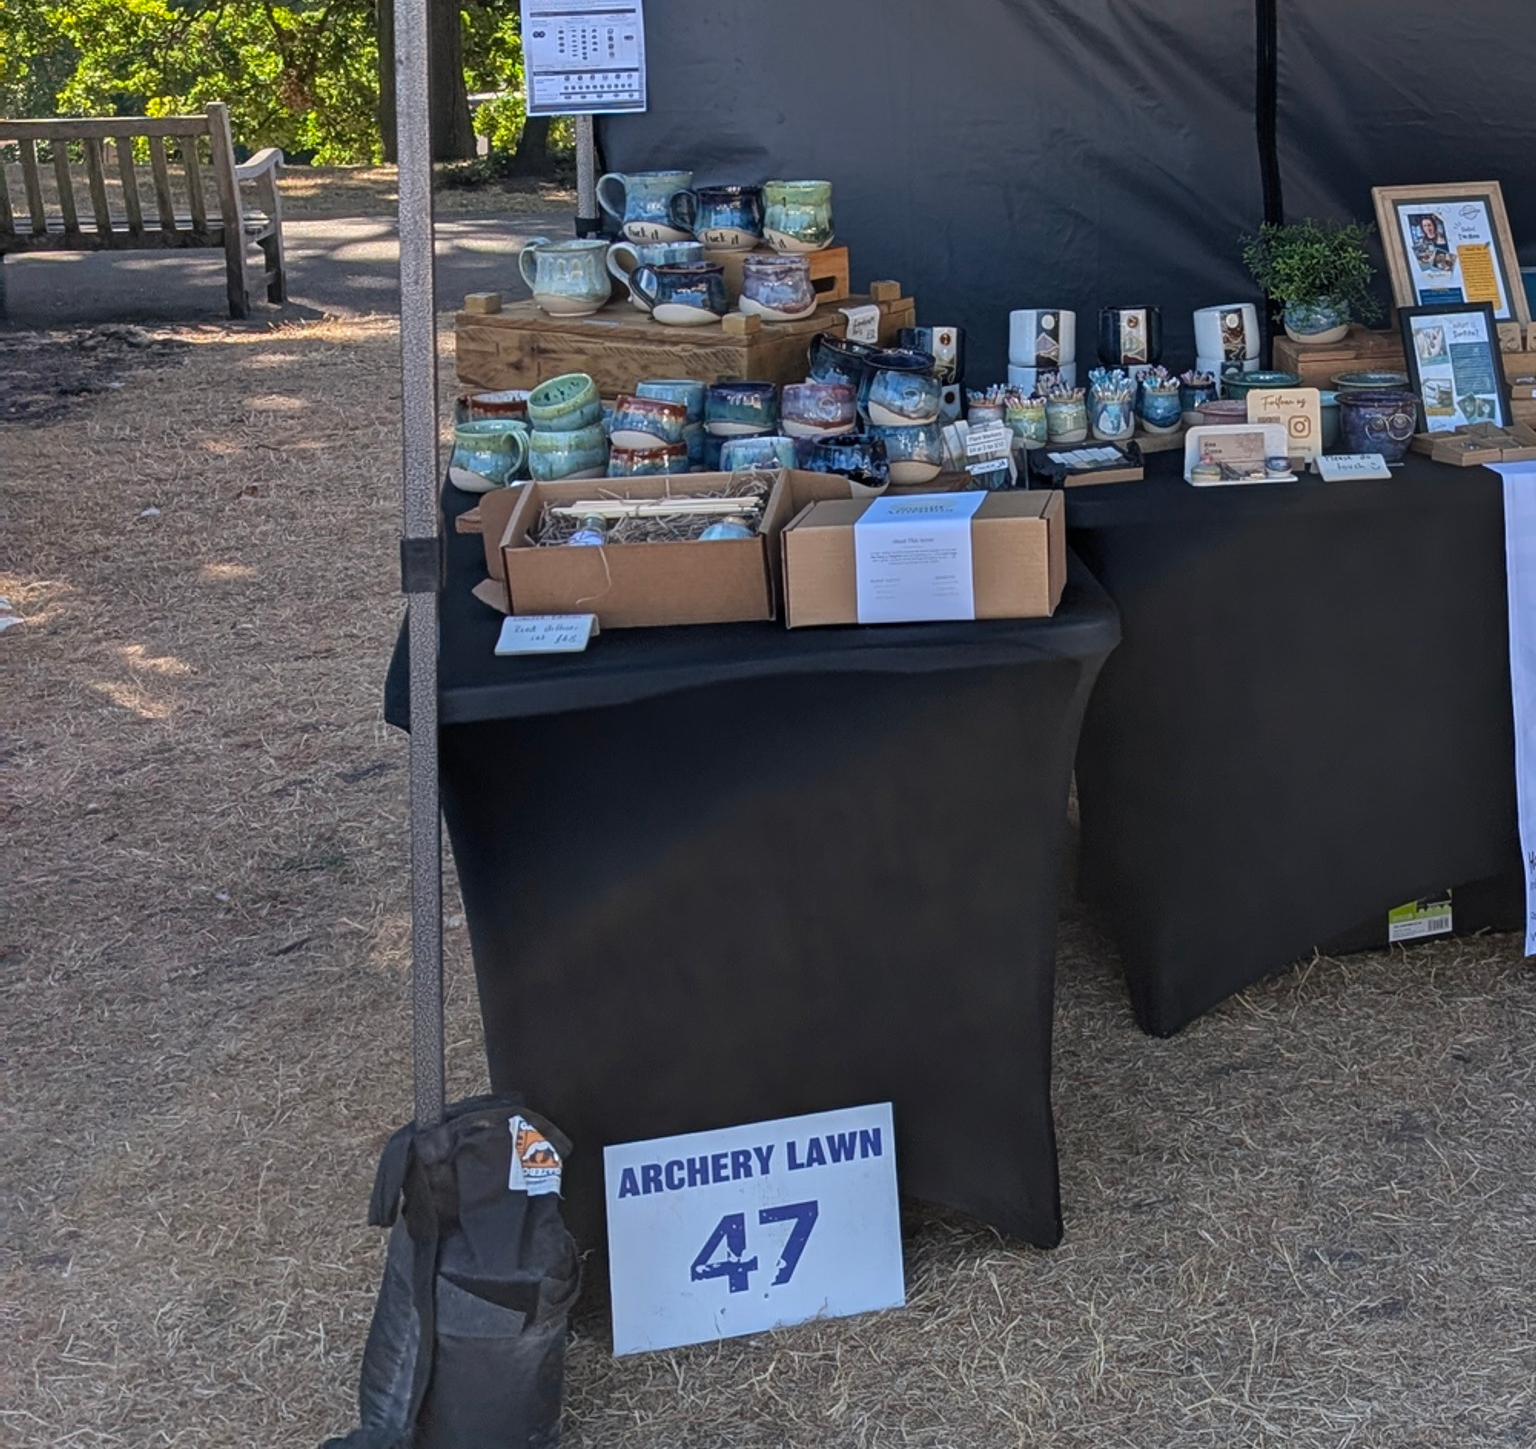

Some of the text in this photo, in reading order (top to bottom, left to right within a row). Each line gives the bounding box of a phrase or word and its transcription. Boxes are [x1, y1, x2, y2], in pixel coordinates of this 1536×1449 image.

[704, 232, 740, 246] Fuck it
[618, 1127, 883, 1199] ARCHERY LAWN
[690, 1199, 819, 1294] 47
